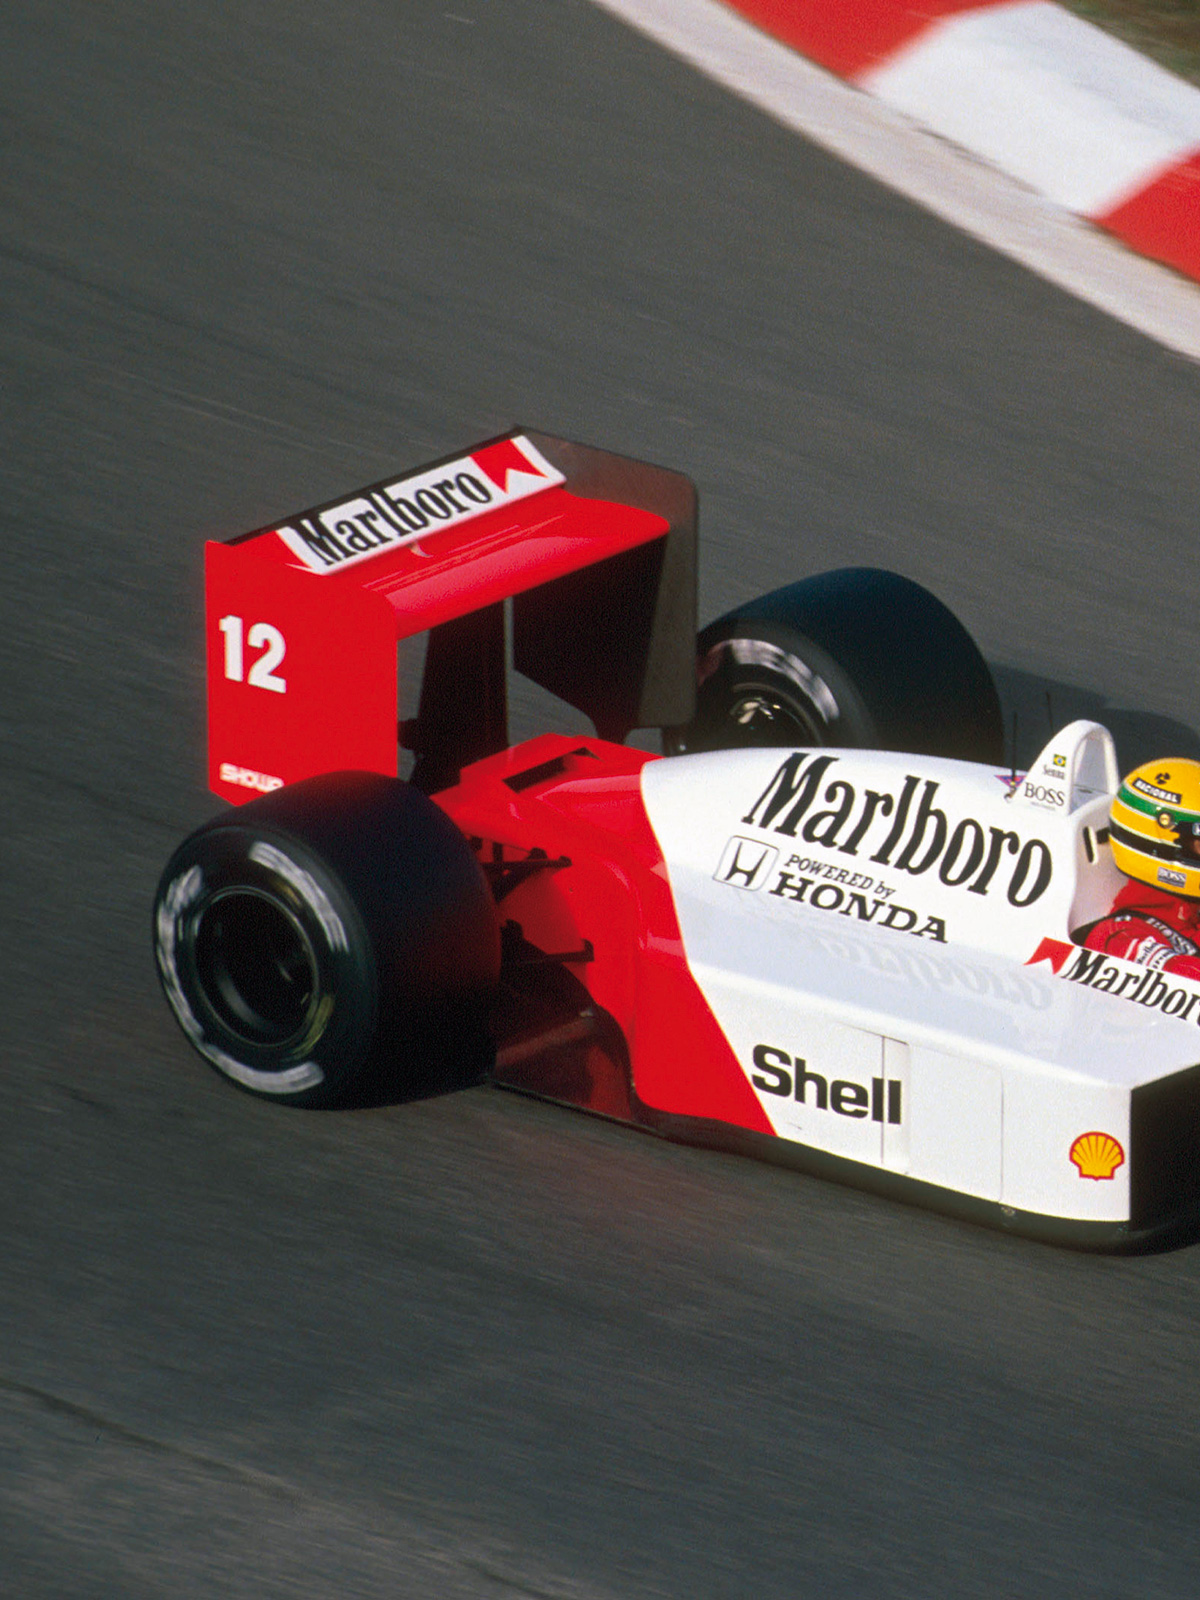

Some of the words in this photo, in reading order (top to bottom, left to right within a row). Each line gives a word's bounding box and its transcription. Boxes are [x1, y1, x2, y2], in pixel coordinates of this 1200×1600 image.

[297, 470, 492, 566] Marlboro
[219, 615, 286, 694] 12
[741, 752, 1053, 907] Marlboro
[1024, 782, 1066, 807] BOSS
[769, 871, 949, 944] HONDA
[784, 854, 874, 889] POWERED
[874, 880, 897, 899] by
[751, 1044, 902, 1126] Shell
